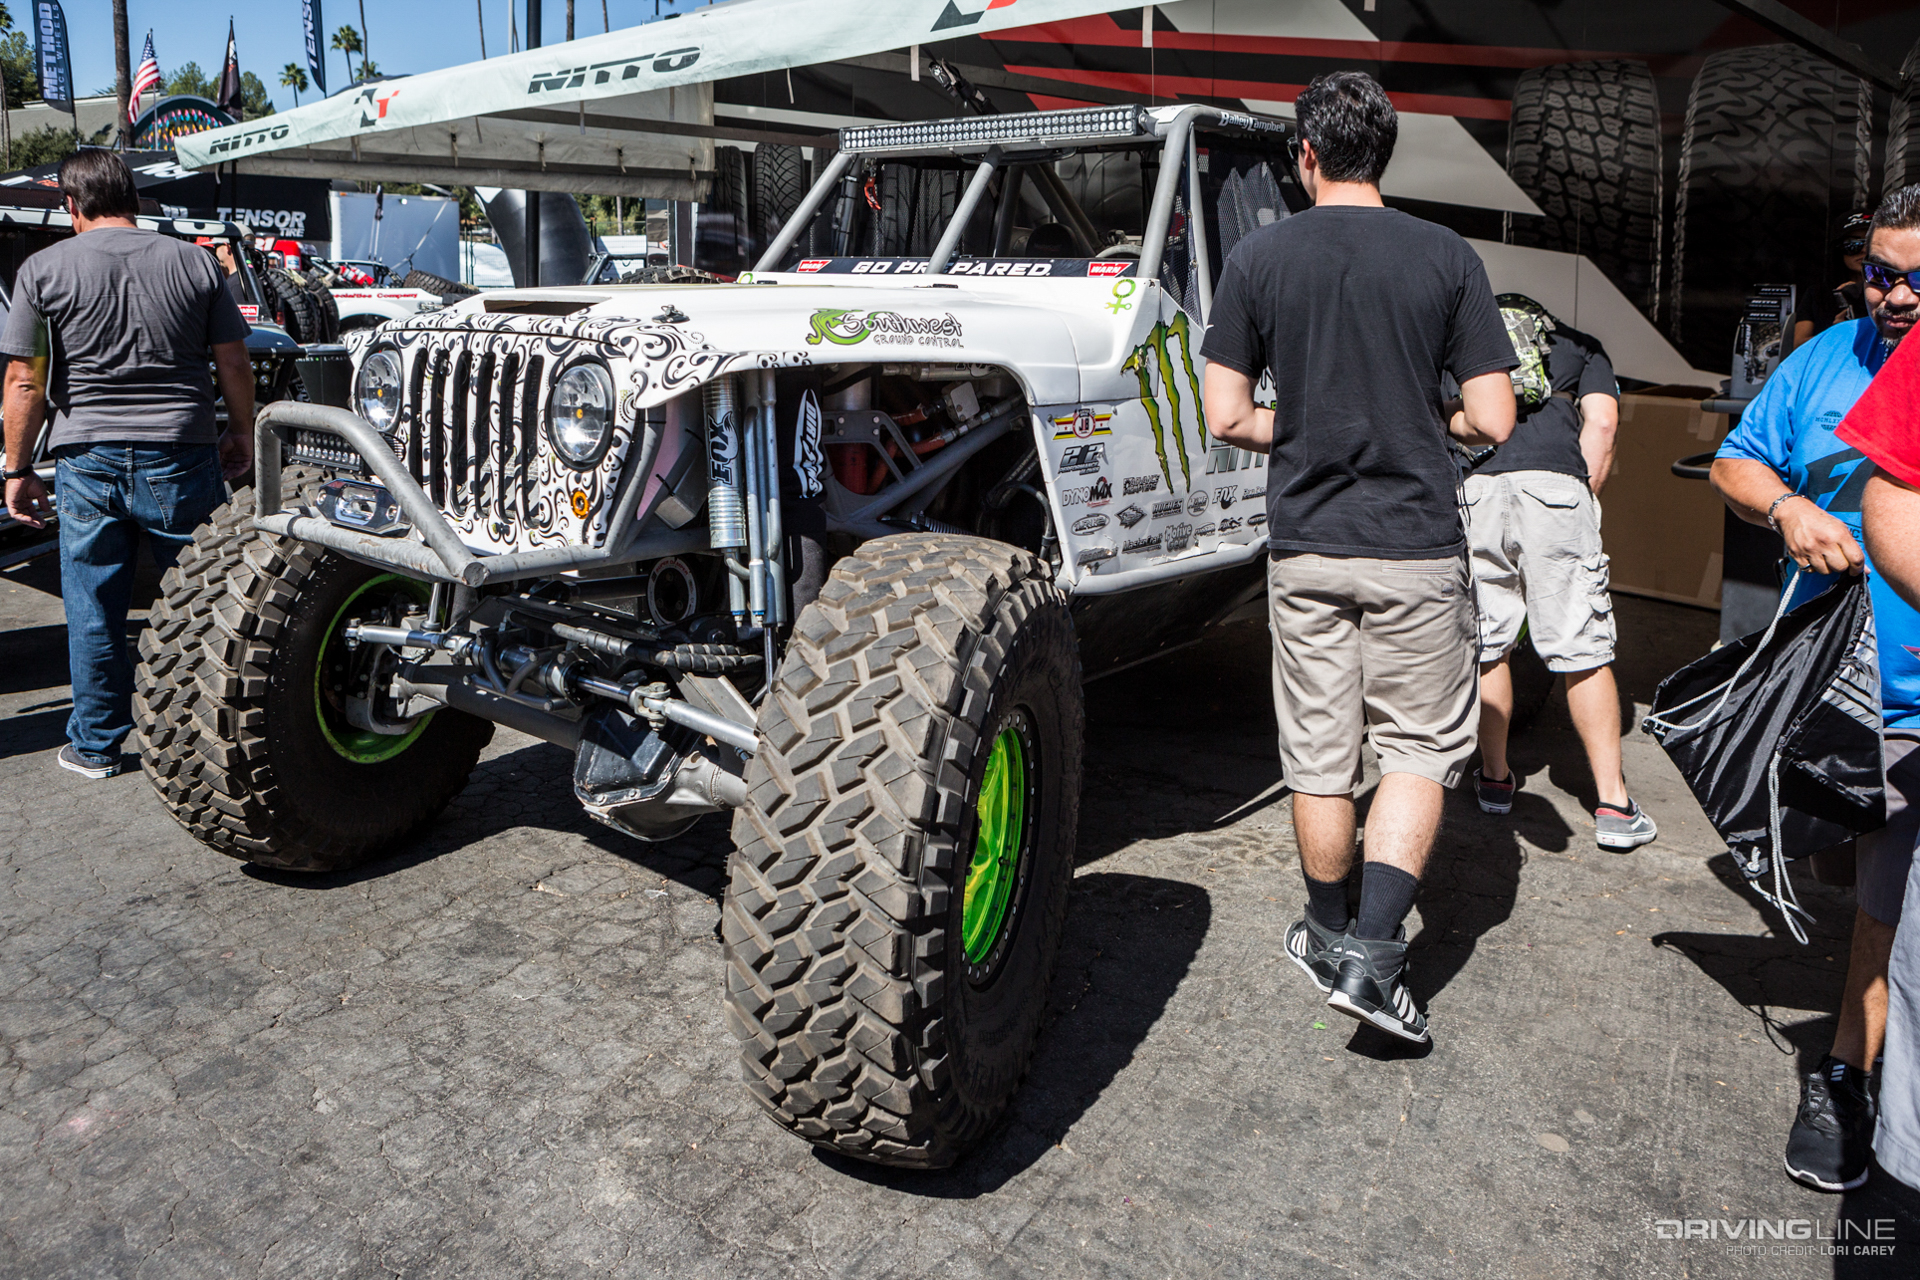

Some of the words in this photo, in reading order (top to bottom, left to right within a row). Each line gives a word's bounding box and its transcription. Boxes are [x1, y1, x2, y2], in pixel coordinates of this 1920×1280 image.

[52, 4, 63, 60] WHEELS
[303, 0, 318, 69] TENS
[39, 2, 58, 99] METHOD
[527, 46, 701, 94] NITTO
[58, 67, 66, 101] RACE
[209, 124, 289, 155] NITTO
[217, 207, 306, 228] TENSOR
[280, 228, 305, 237] TIRE
[851, 261, 893, 273] GO
[894, 261, 1052, 277] PRPARED.
[1090, 265, 1121, 274] WARN
[842, 311, 962, 337] Southwest
[873, 334, 915, 346] GROUND
[918, 335, 964, 349] CONTROL
[708, 411, 738, 485] FOX
[1062, 479, 1113, 507] DYNOMAX
[1212, 485, 1238, 509] FOX
[1152, 500, 1182, 514] HUGHES
[1165, 522, 1192, 541] Motive
[1166, 537, 1188, 552] Gear
